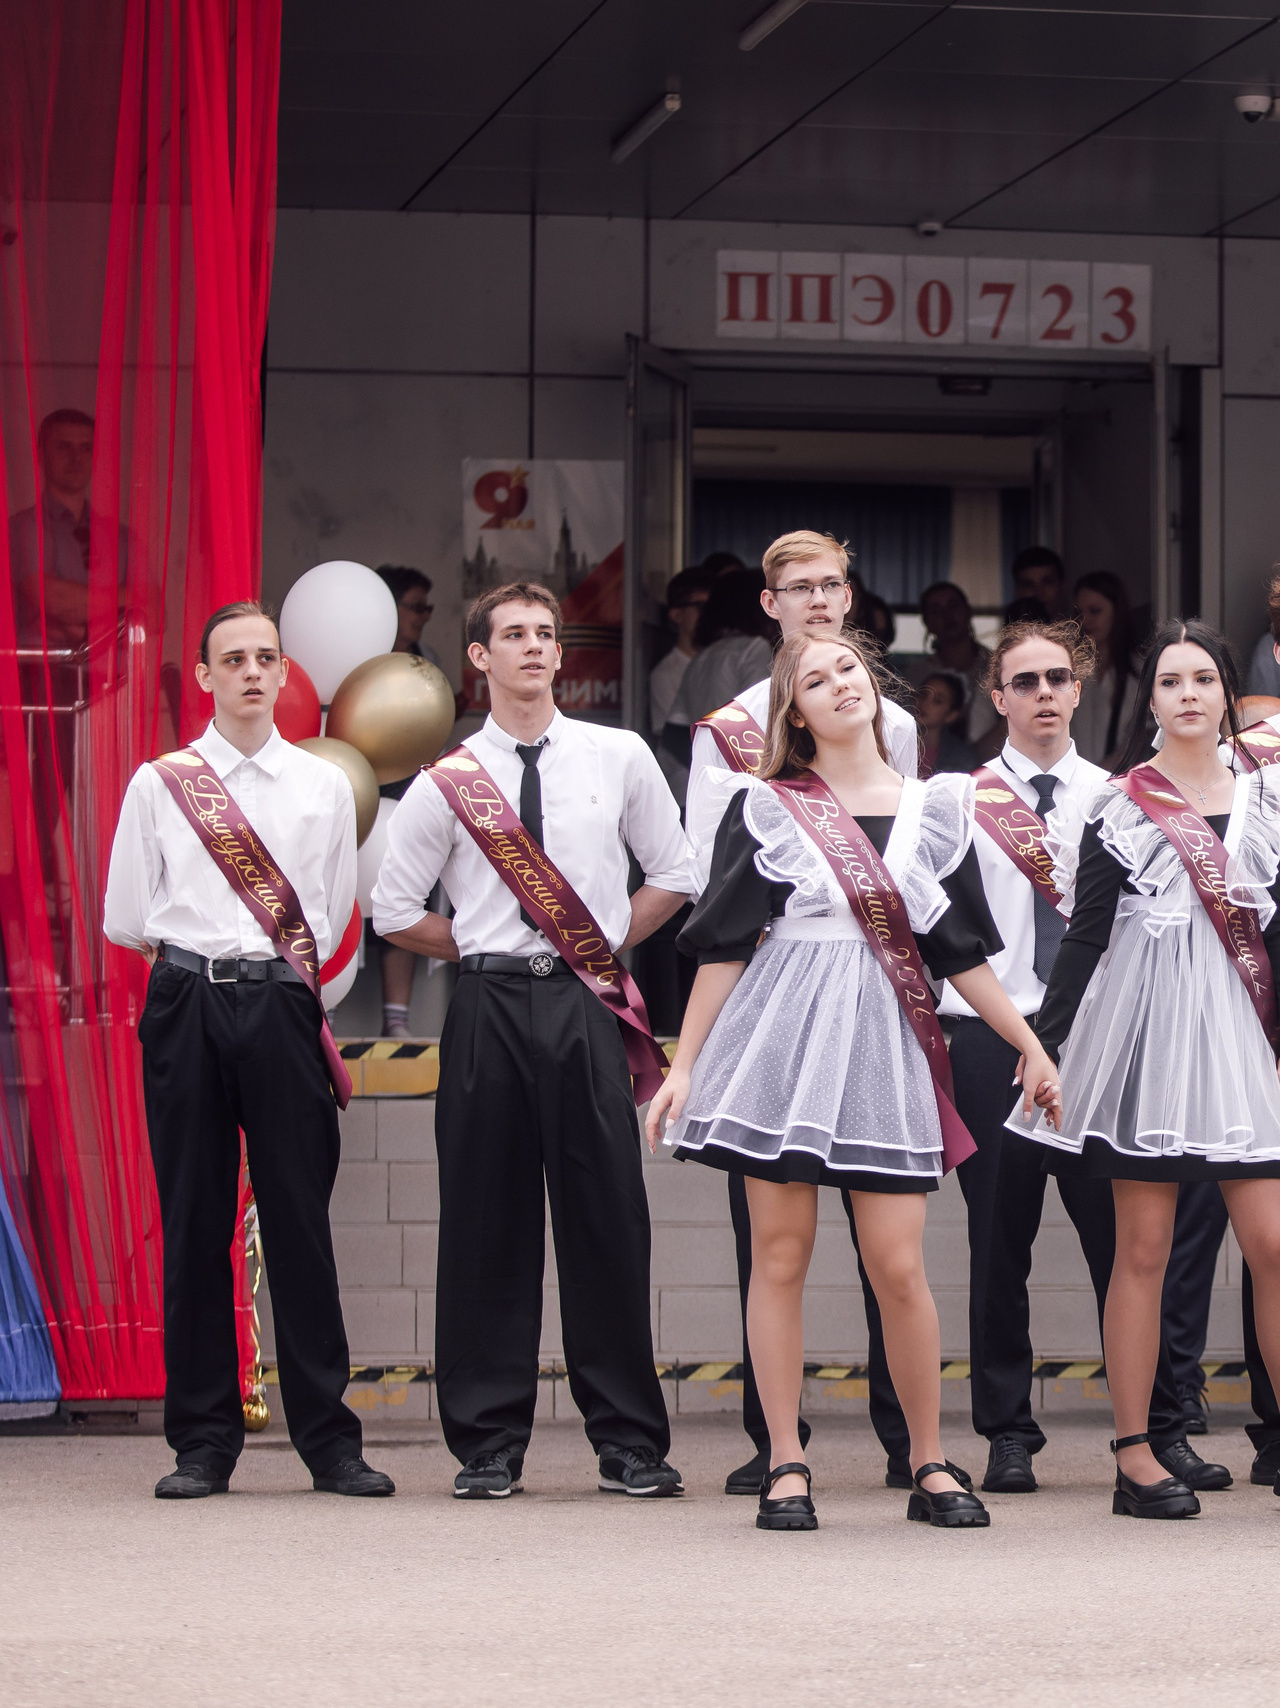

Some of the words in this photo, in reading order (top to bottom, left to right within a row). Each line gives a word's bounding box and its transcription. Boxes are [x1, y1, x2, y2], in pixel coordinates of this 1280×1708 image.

[183, 774, 287, 918] Выпускник
[459, 779, 567, 920] Выпускник
[561, 921, 614, 986] 2026
[793, 783, 891, 943] Выпускница
[887, 947, 931, 1022] 2026
[1169, 812, 1259, 977] Выпускница
